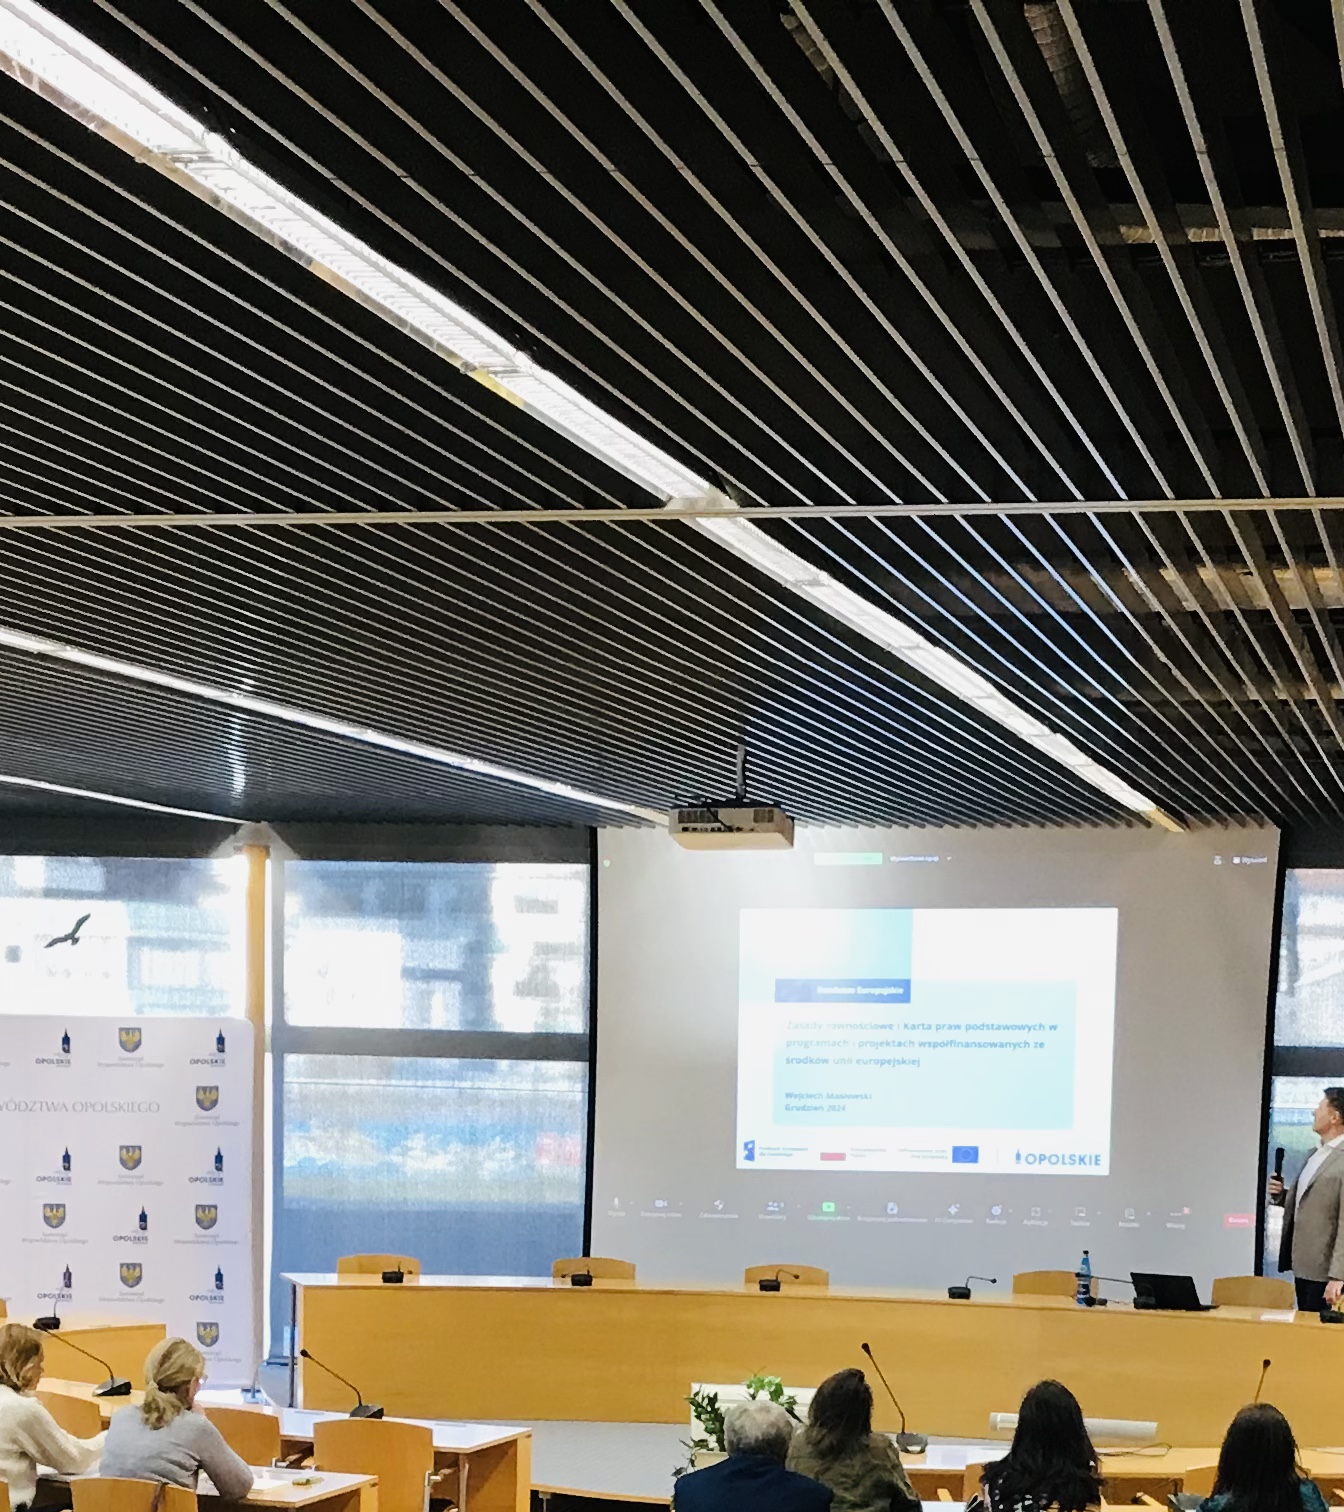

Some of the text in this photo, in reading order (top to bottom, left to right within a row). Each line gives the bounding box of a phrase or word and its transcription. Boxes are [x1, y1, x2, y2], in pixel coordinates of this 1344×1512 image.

[903, 1022, 932, 1031] Karta
[935, 1023, 962, 1033] praw
[965, 1022, 1045, 1033] podstawowych
[1049, 1023, 1058, 1031] w
[858, 1039, 915, 1050] projektach
[918, 1039, 1030, 1051] współfinansowanych
[1033, 1041, 1045, 1049] ze
[856, 1056, 920, 1067] europejskiej
[72, 1100, 160, 1114] OPOLSKIEGO
[1024, 1152, 1101, 1166] OPOLSKIE
